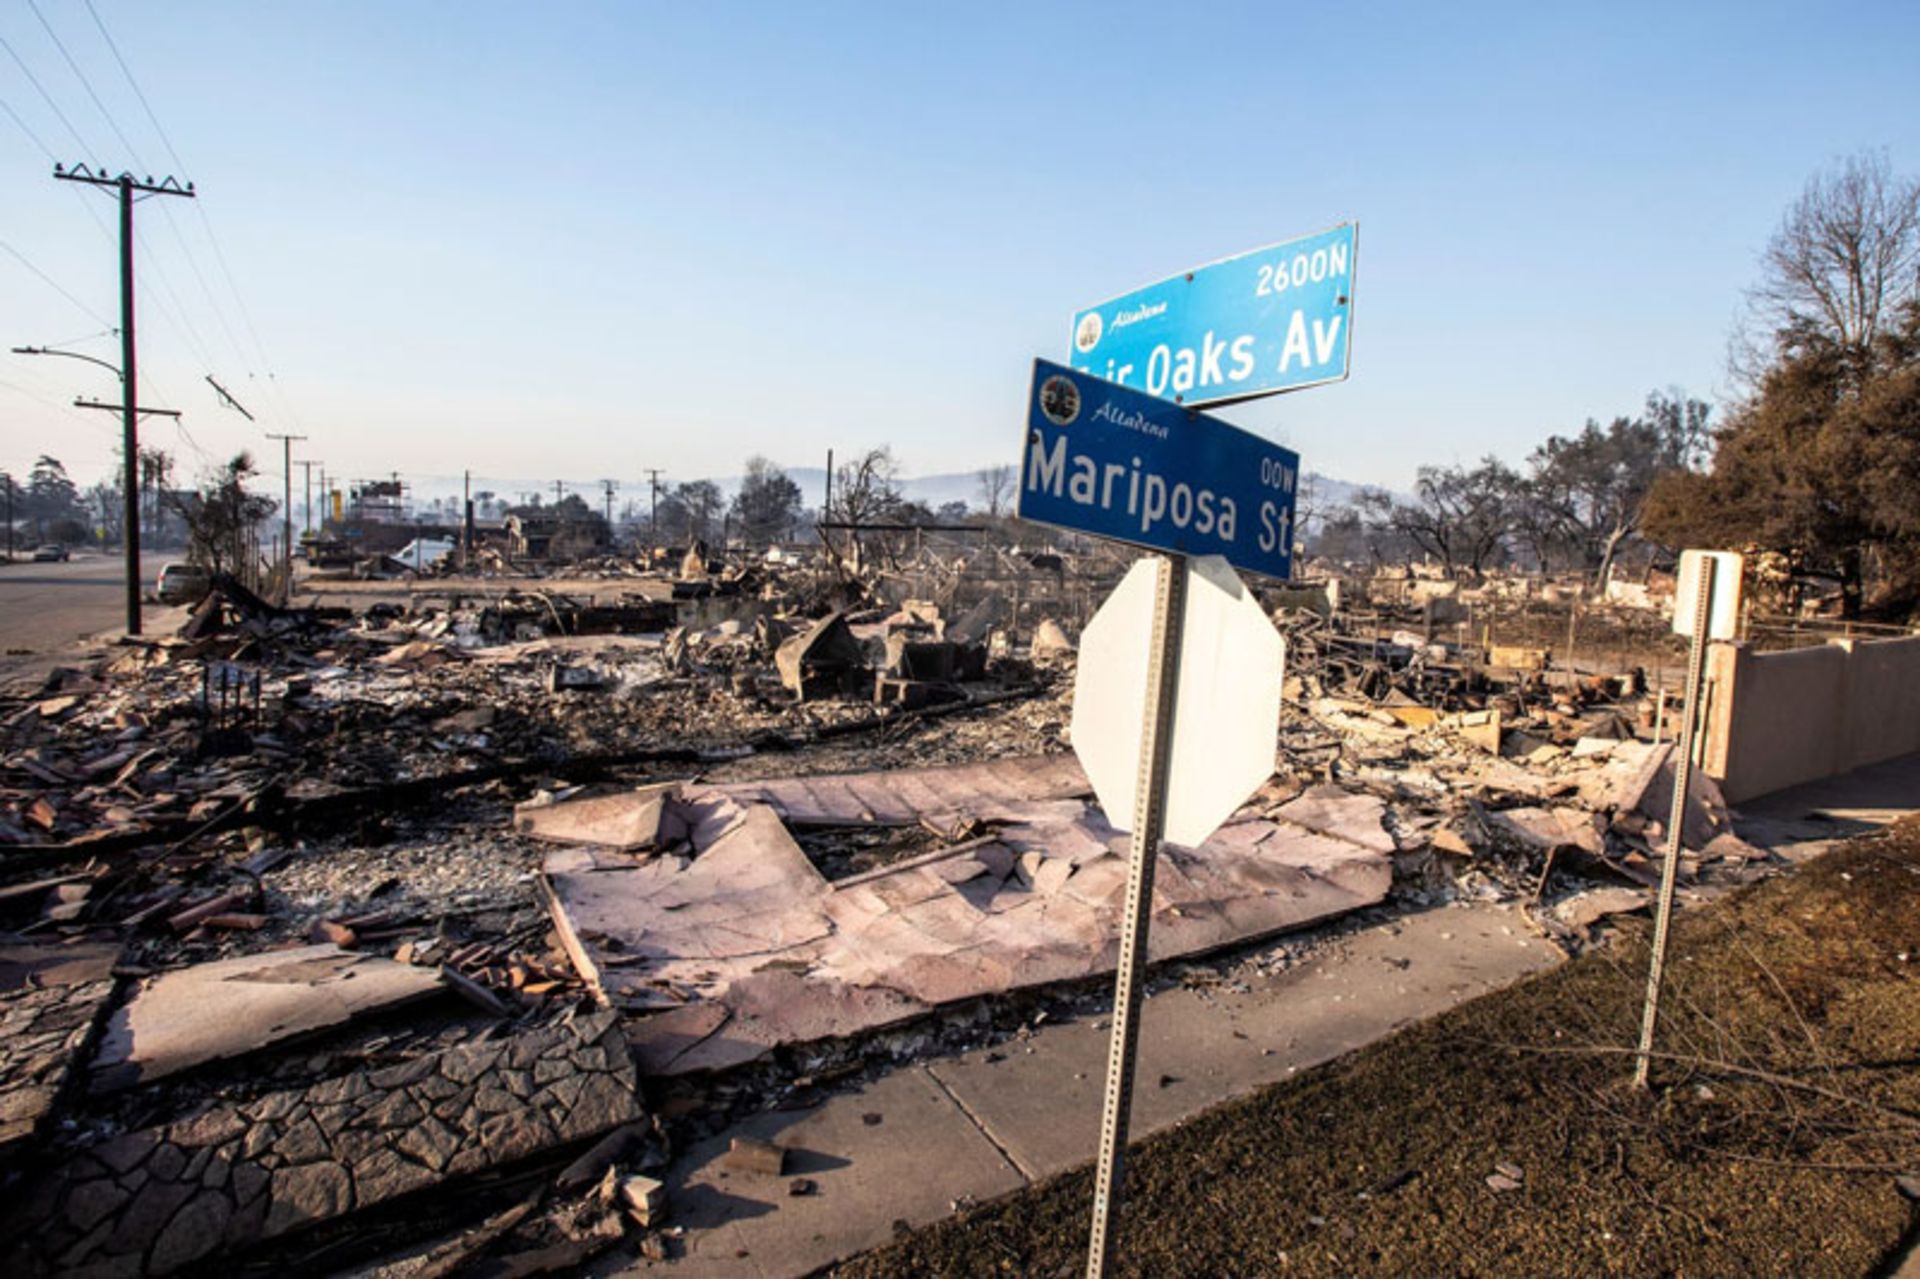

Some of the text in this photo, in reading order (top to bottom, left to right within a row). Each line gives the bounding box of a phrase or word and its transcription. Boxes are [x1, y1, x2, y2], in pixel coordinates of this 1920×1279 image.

[1256, 244, 1347, 297] 2600N
[1147, 331, 1255, 395] Oaks
[1278, 310, 1342, 373] Av
[1091, 402, 1169, 439] Altadena
[1028, 429, 1289, 556] Mariposa St
